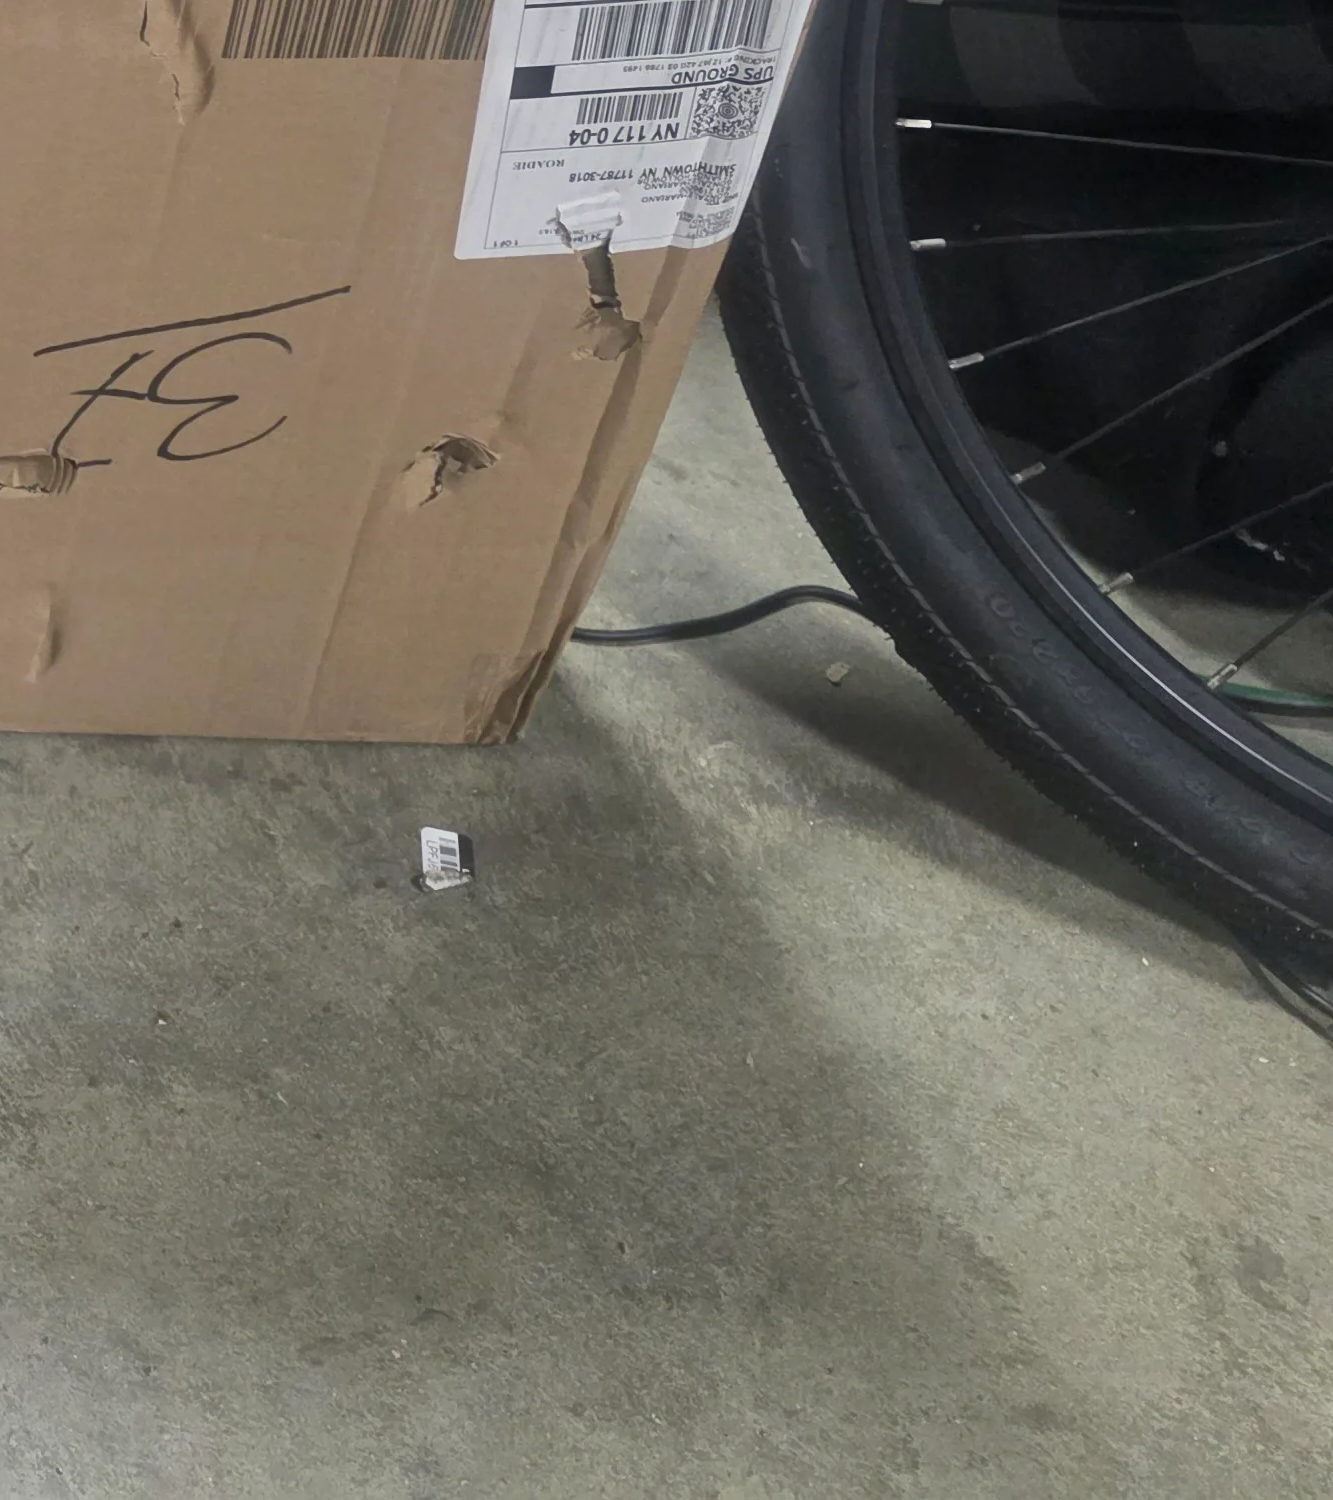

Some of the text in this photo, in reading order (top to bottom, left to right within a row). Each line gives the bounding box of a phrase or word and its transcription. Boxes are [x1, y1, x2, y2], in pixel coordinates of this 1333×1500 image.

[671, 64, 773, 84] UPS GROUND
[651, 122, 679, 141] NY
[513, 159, 564, 170] ROADIE
[569, 169, 633, 182] 11787-3018
[640, 168, 657, 179] NY
